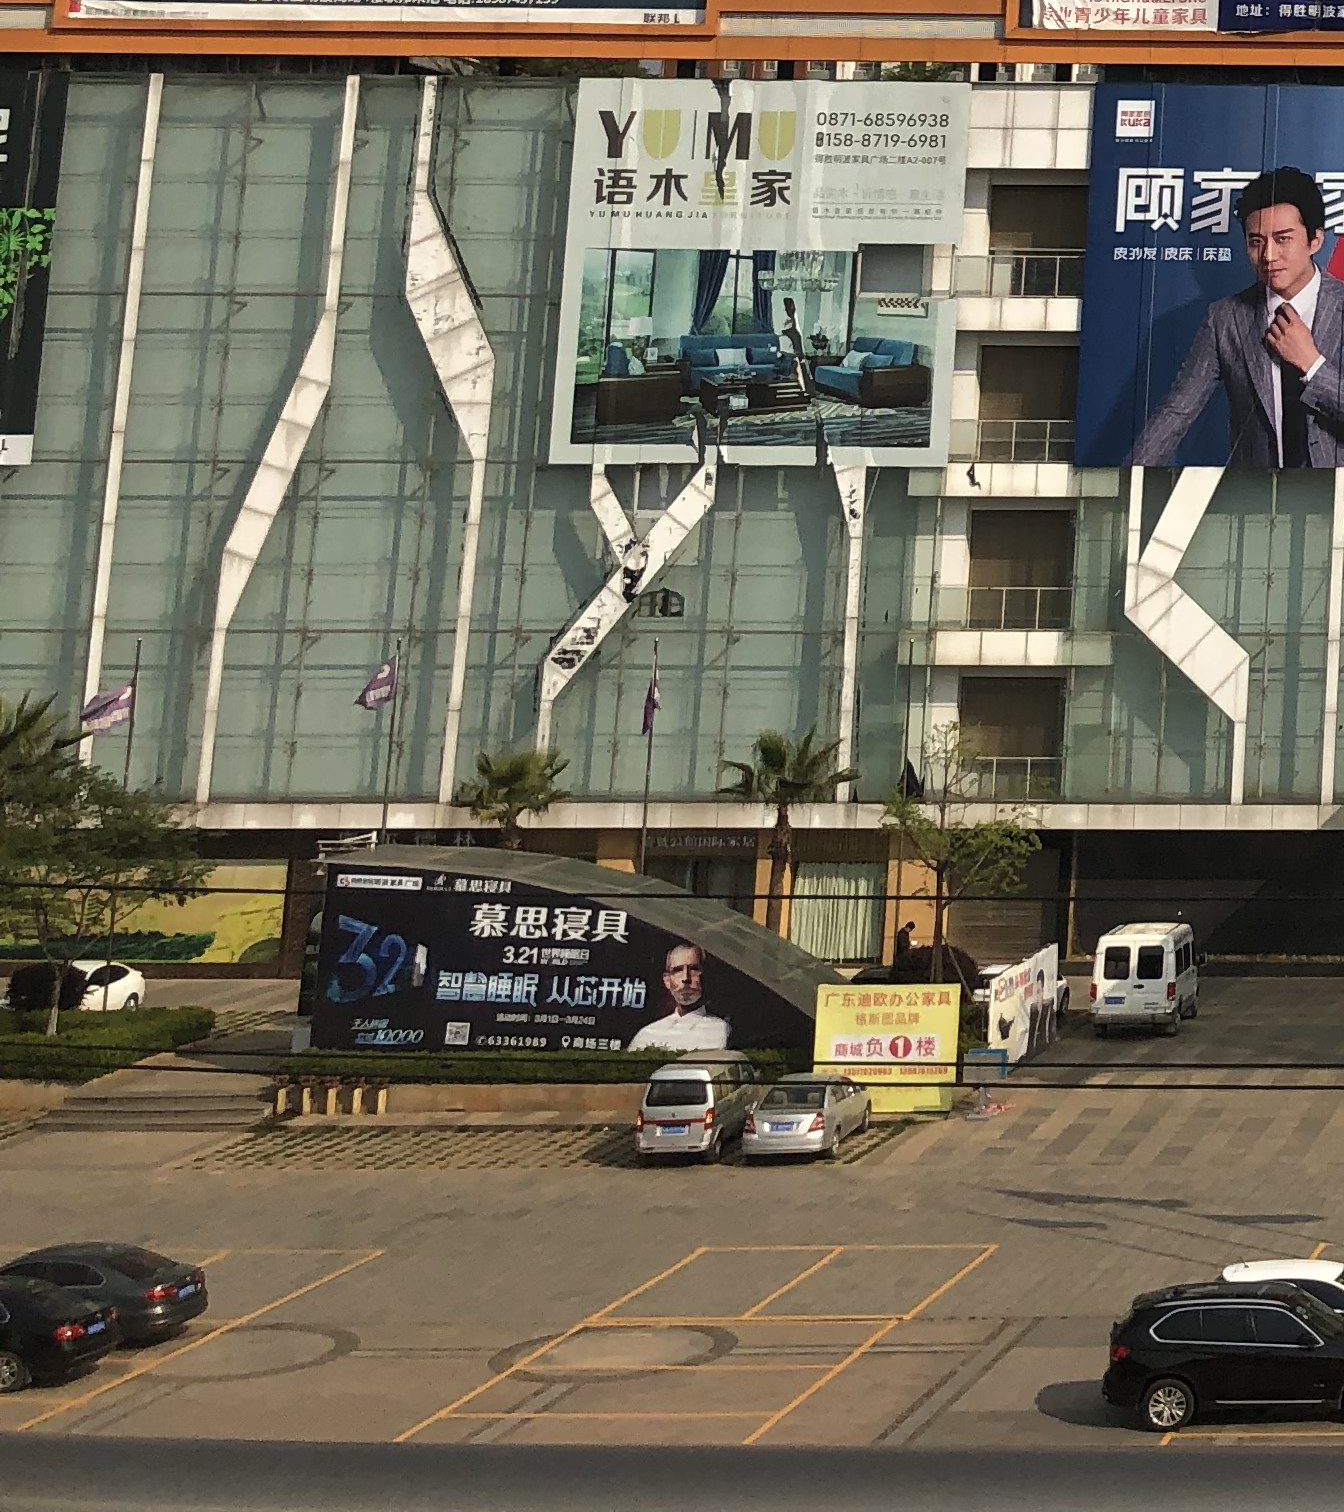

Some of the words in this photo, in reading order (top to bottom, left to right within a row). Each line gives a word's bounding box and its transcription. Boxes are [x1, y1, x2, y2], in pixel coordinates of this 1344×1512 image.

[816, 111, 950, 128] 0871-68596938
[825, 133, 947, 149] 158-8719-6981
[594, 168, 793, 208] 语木皇家
[1164, 246, 1194, 261] 皮床
[1203, 246, 1232, 262] 床垫
[469, 901, 630, 945] 慕思寝具
[502, 945, 539, 965] 3.21
[435, 969, 540, 1008] 智慧睡眠
[546, 974, 647, 1009] 从芯开始
[824, 991, 952, 1008] 广东迪欧办公家具
